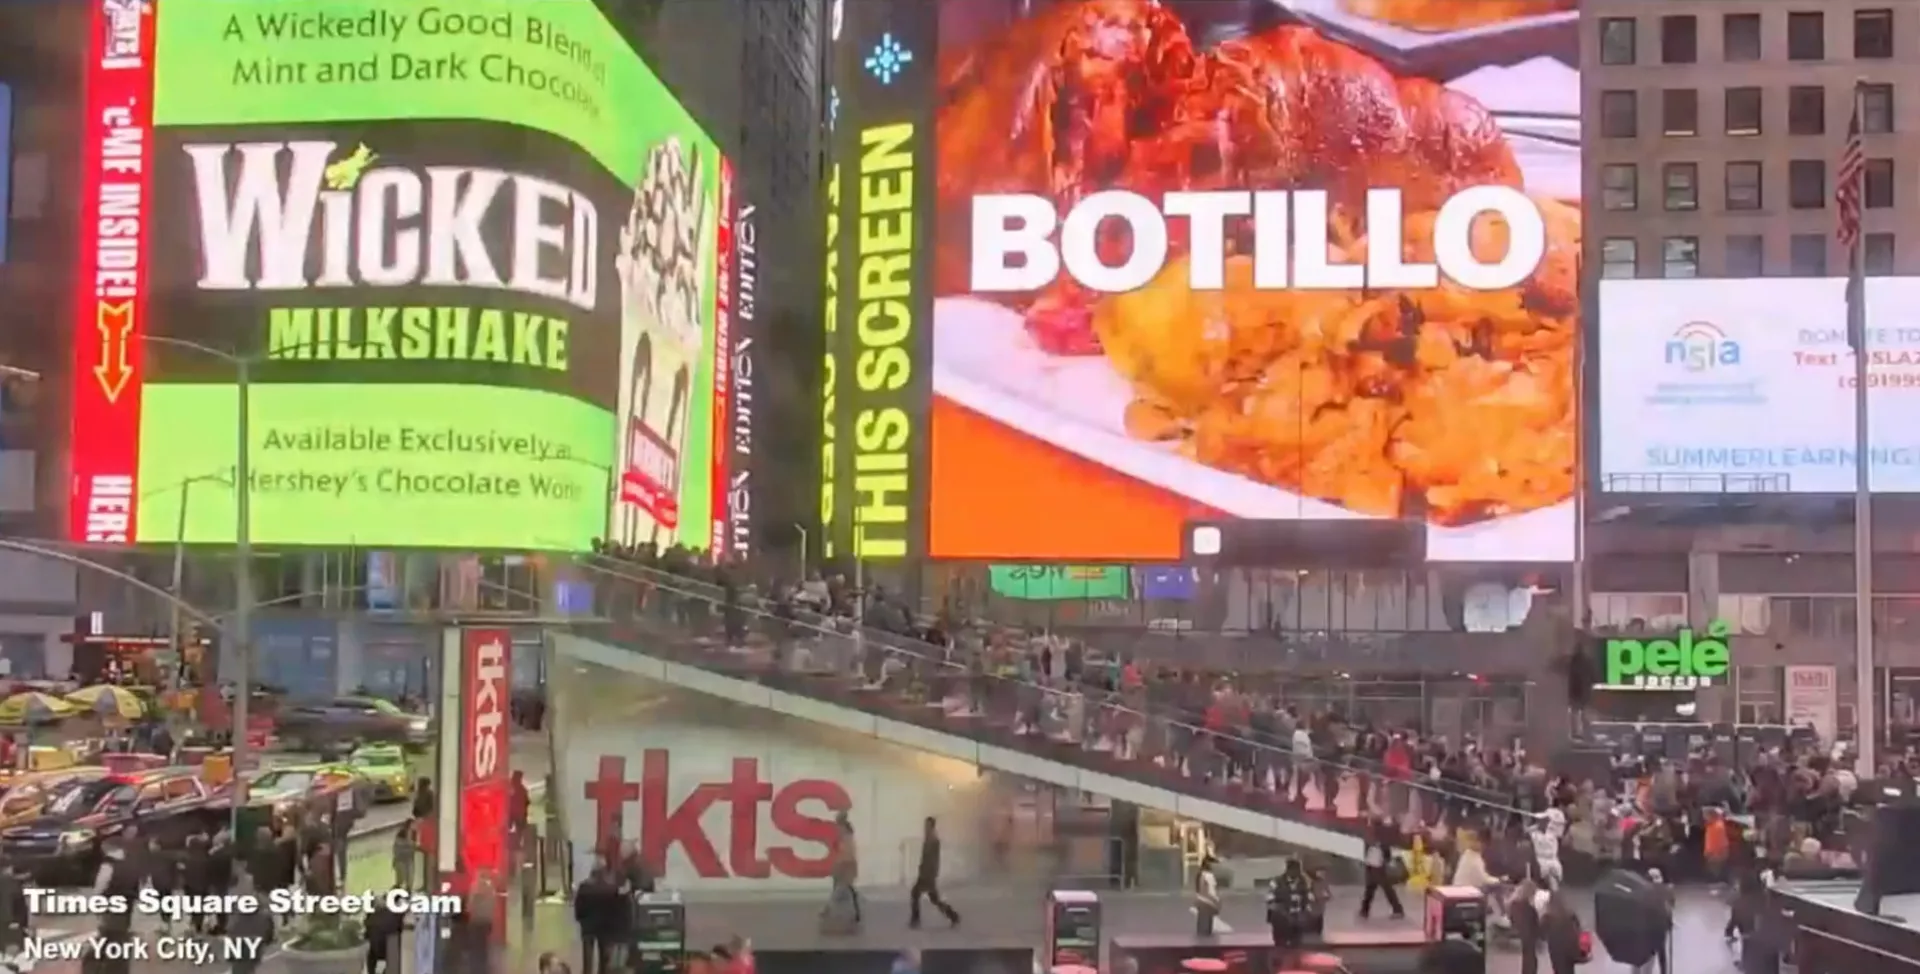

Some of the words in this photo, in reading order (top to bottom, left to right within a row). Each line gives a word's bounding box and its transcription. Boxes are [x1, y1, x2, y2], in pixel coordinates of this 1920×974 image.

[222, 14, 244, 41] A
[256, 10, 407, 42] Wickedly
[418, 7, 512, 38] Good
[232, 58, 315, 85] Mint
[316, 54, 378, 83] and
[391, 52, 468, 82] Dark
[96, 183, 141, 297] INSIDE!
[857, 122, 914, 391] SCREEN
[971, 184, 1545, 291] BOTILLO
[269, 307, 569, 370] MILKSHAKE
[1793, 351, 1837, 365] Text
[263, 428, 391, 450] Available
[401, 427, 550, 461] Exclusively
[376, 468, 520, 495] Chocolate
[853, 407, 907, 559] THIS
[1607, 619, 1729, 685] pelé
[474, 638, 504, 778] tkts
[584, 748, 852, 878] tkts
